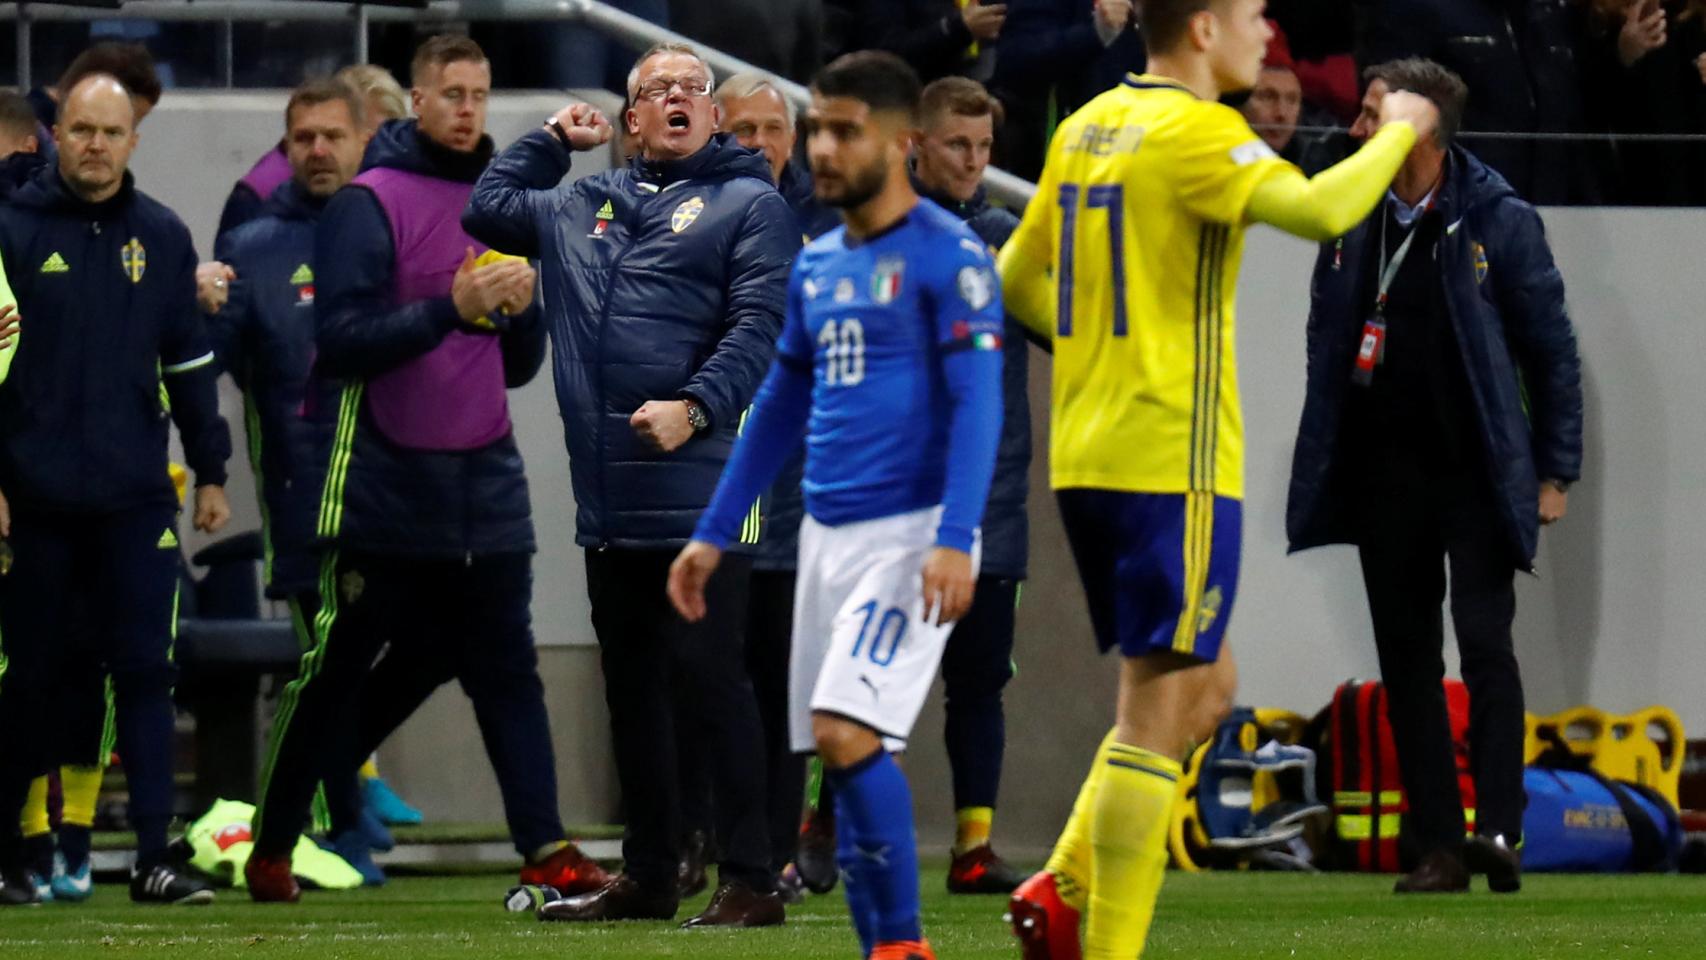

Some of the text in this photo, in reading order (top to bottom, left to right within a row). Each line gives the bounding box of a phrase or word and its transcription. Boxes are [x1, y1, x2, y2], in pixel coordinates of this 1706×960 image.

[1057, 183, 1128, 337] 17
[818, 317, 865, 386] 10
[852, 598, 909, 667] 10
